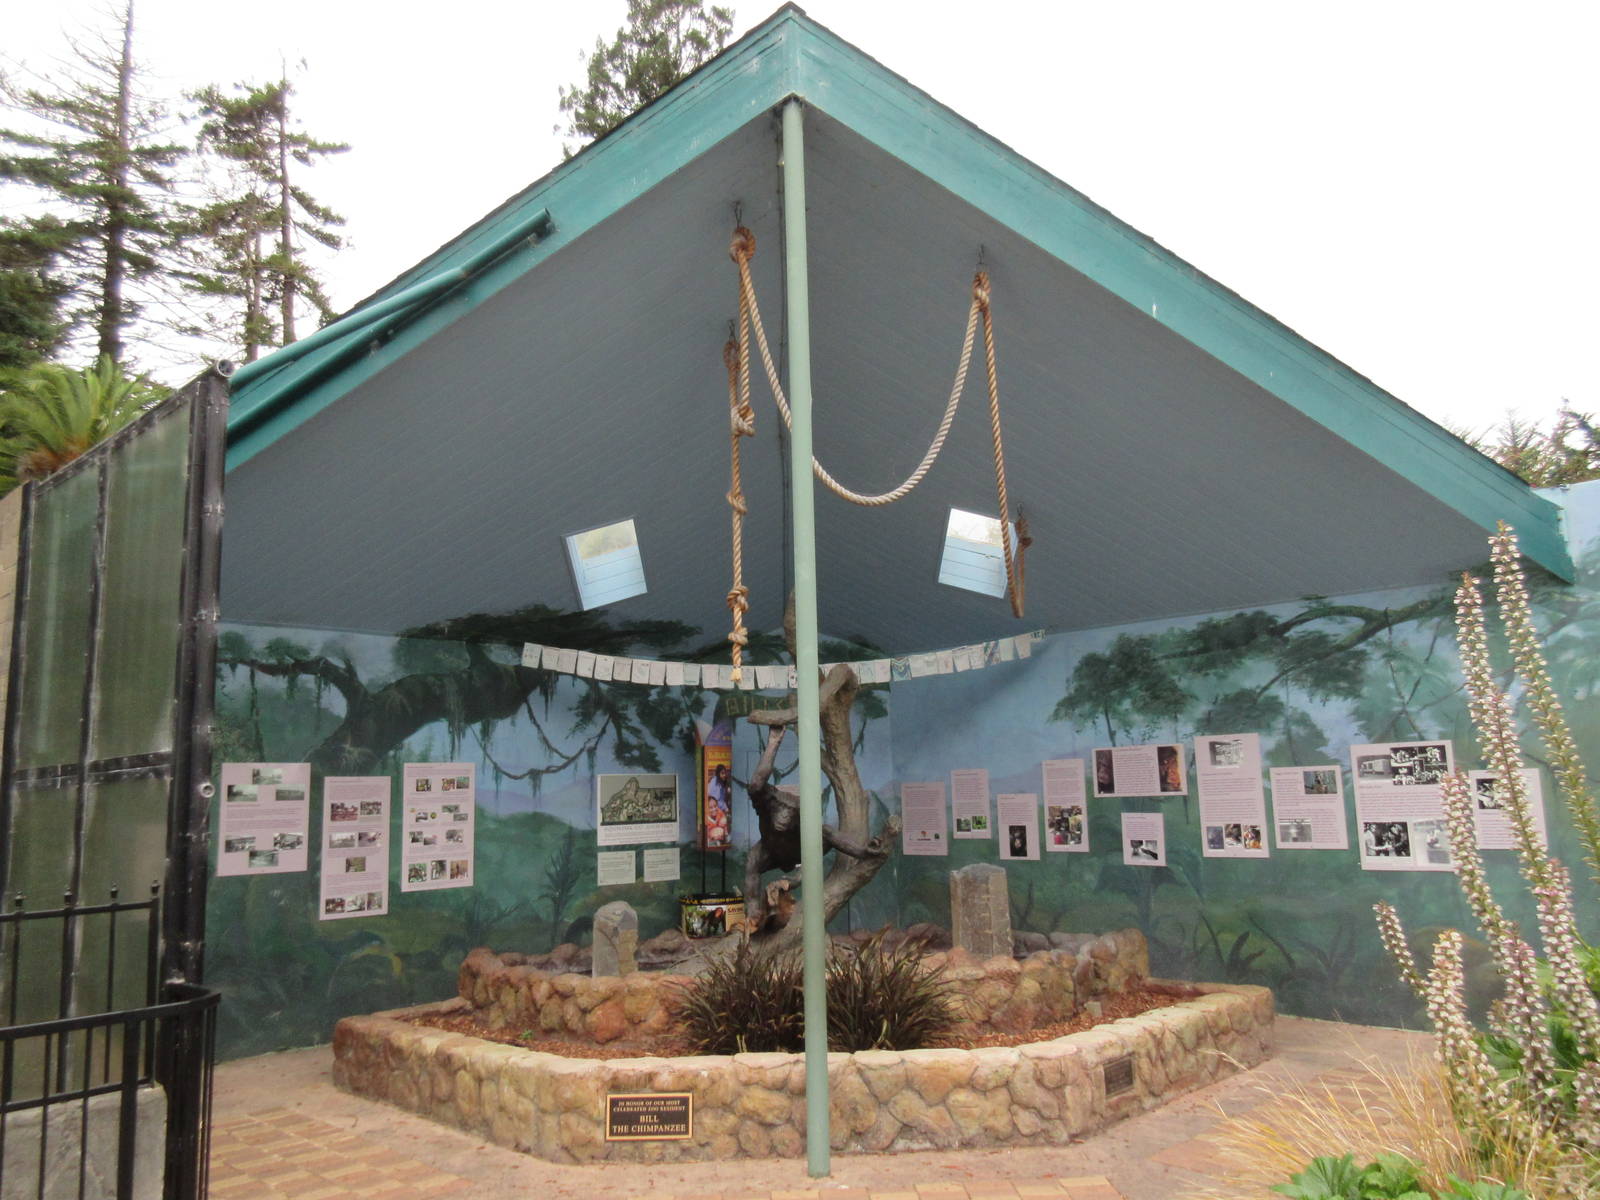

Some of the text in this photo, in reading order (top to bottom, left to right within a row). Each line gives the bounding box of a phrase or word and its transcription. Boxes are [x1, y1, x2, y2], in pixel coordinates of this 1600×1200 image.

[639, 1115, 659, 1123] BILL
[612, 1123, 686, 1133] THE CHIMPANZEE
